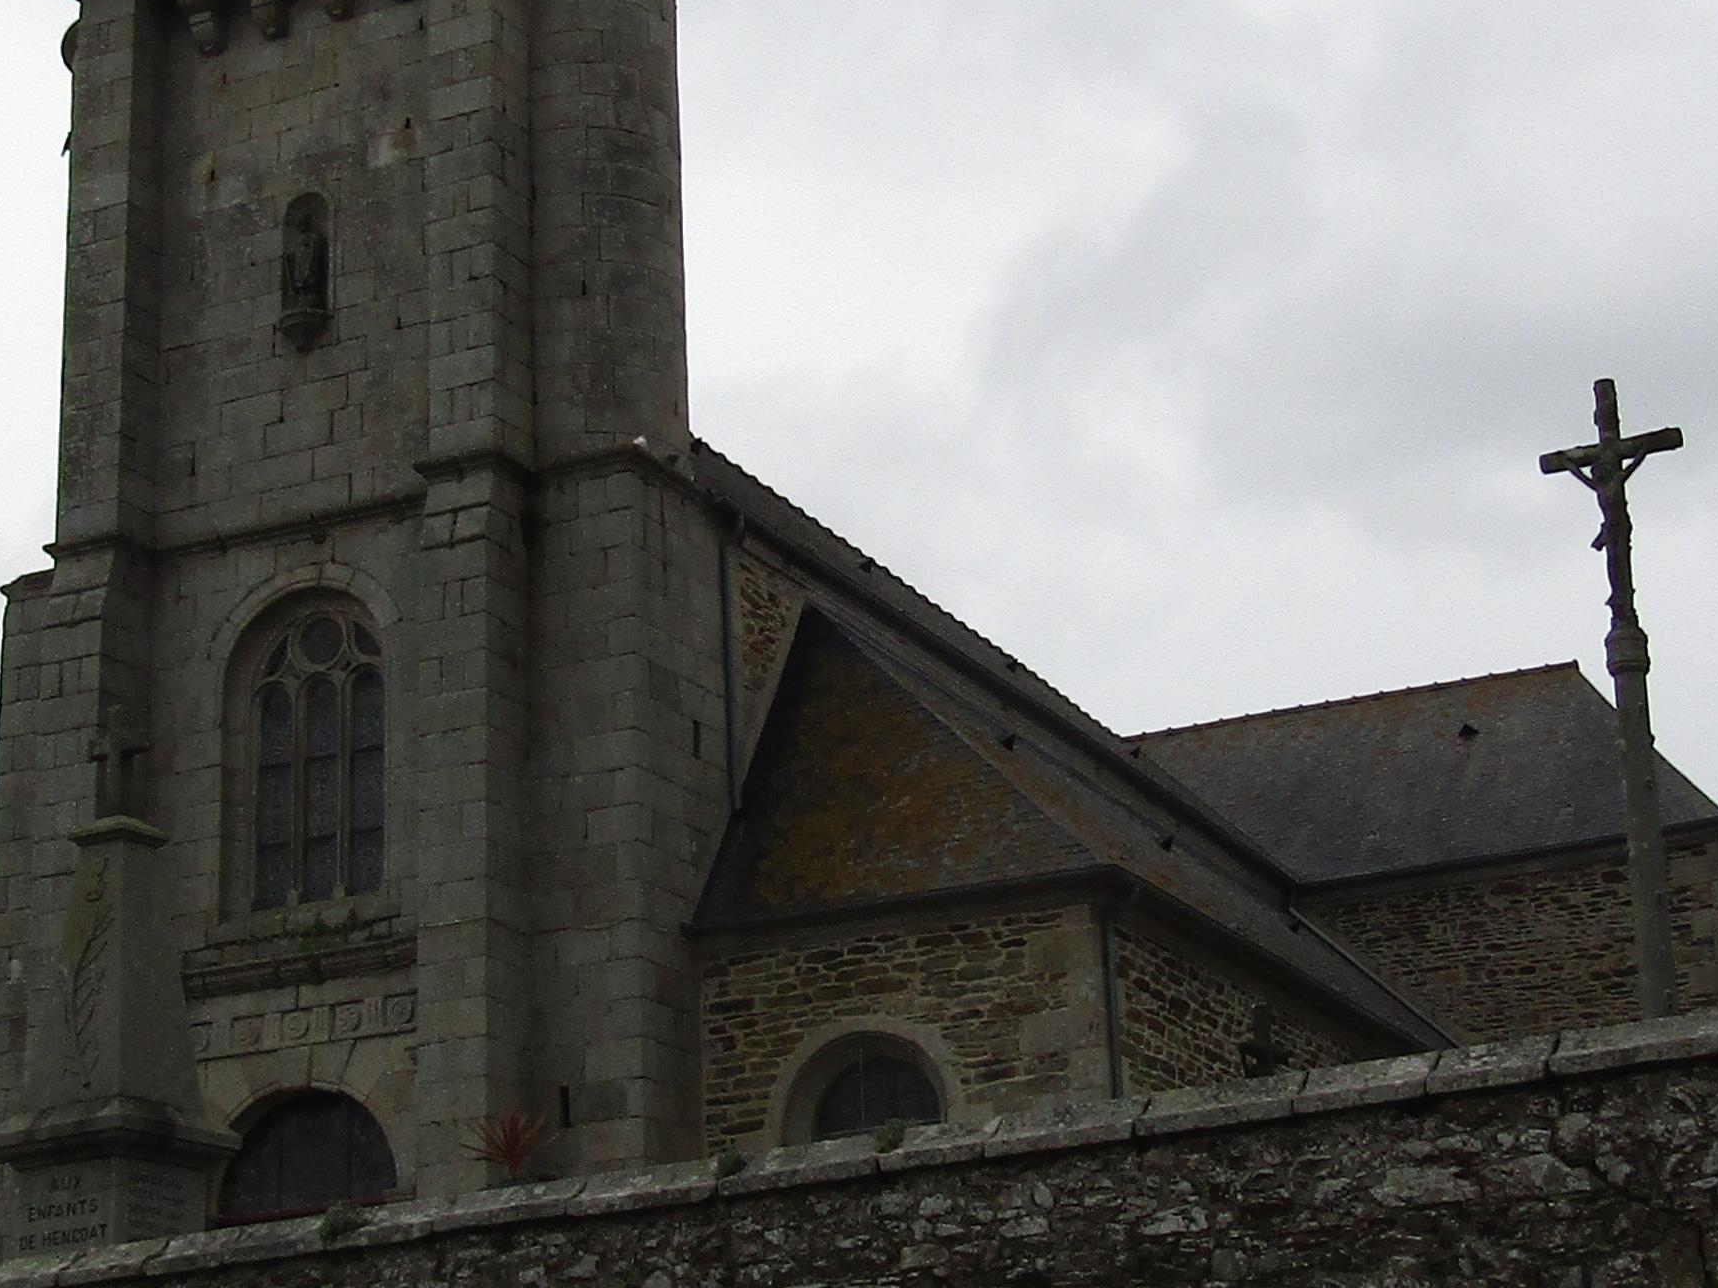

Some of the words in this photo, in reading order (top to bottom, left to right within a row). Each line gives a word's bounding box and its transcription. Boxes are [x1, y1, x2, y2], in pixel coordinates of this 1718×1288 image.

[27, 1198, 100, 1223] ENFANTS
[18, 1233, 36, 1251] DE
[41, 1223, 108, 1247] HENGOAT
